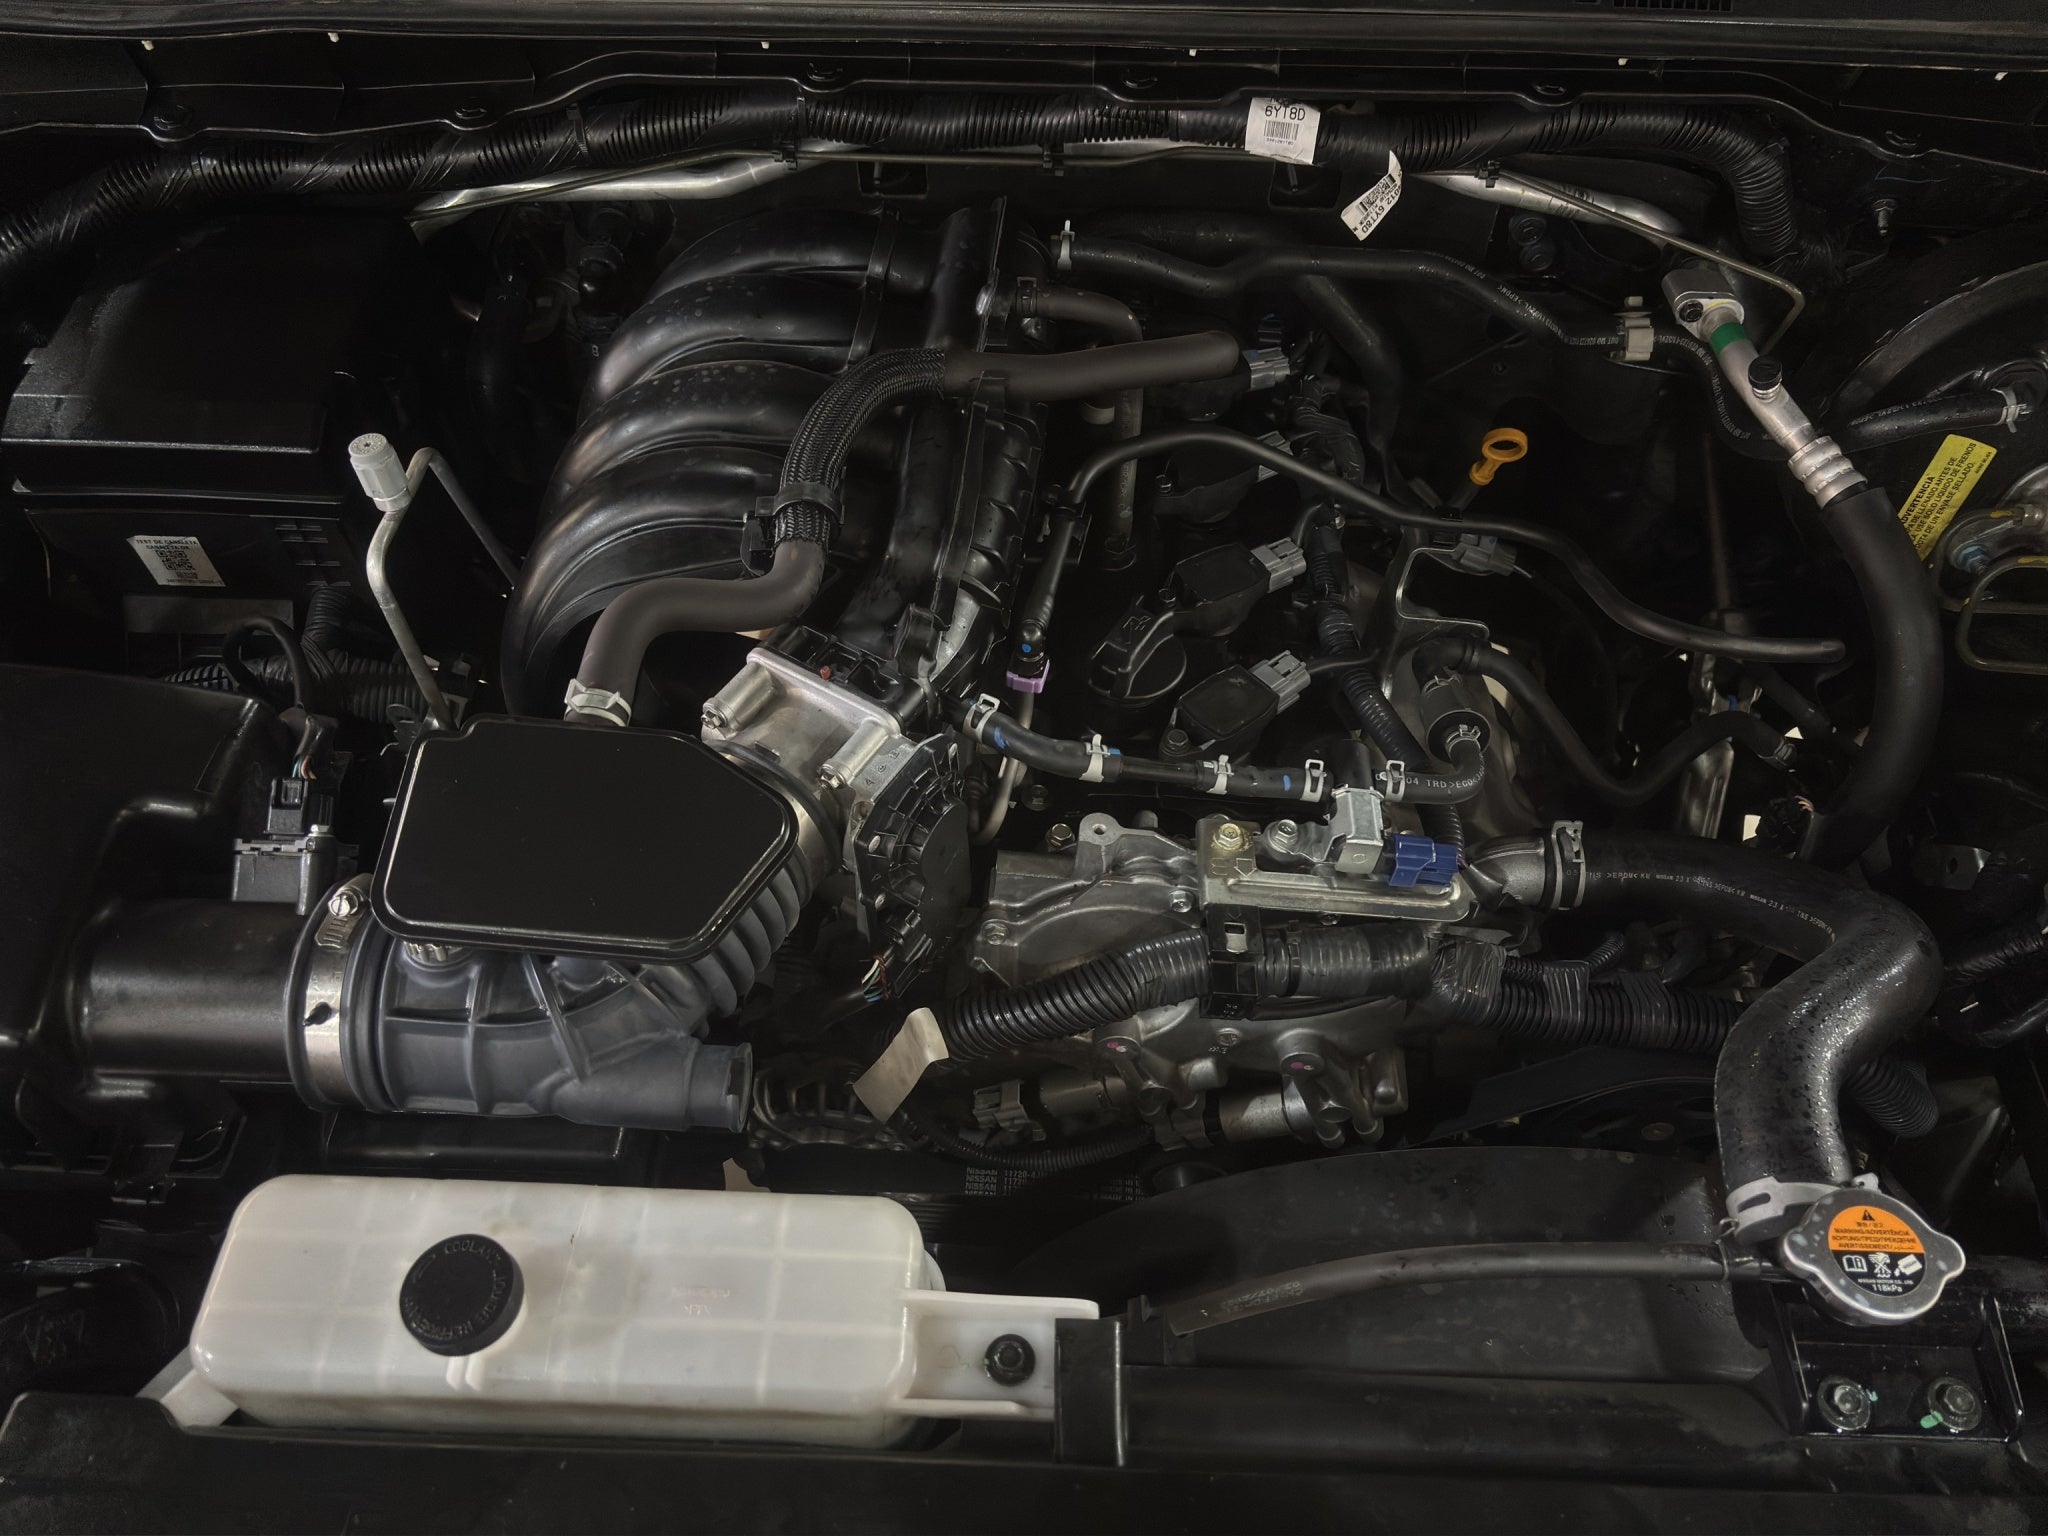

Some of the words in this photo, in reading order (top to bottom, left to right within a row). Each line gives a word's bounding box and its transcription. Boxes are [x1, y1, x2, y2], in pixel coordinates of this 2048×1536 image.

[1264, 105, 1306, 121] 6YT8D
[1361, 206, 1386, 234] 6YT8D
[1914, 518, 1926, 533] USE
[1922, 500, 1938, 520] SOLO
[1933, 476, 1954, 503] LIQUIDO
[1949, 466, 1960, 478] DE
[1956, 442, 1977, 467] FRENOS
[1916, 485, 1938, 515] LLENADO
[1933, 465, 1951, 487] ANTES
[1947, 455, 1957, 466] DE
[1901, 476, 1935, 524] ADVERTENCIA
[1936, 489, 1956, 515] ENVASE
[966, 1168, 998, 1176] NISSAN
[966, 1176, 997, 1184] NISSAN
[965, 1183, 997, 1192] NISSAN
[1872, 1284, 1903, 1292] 118kPa
